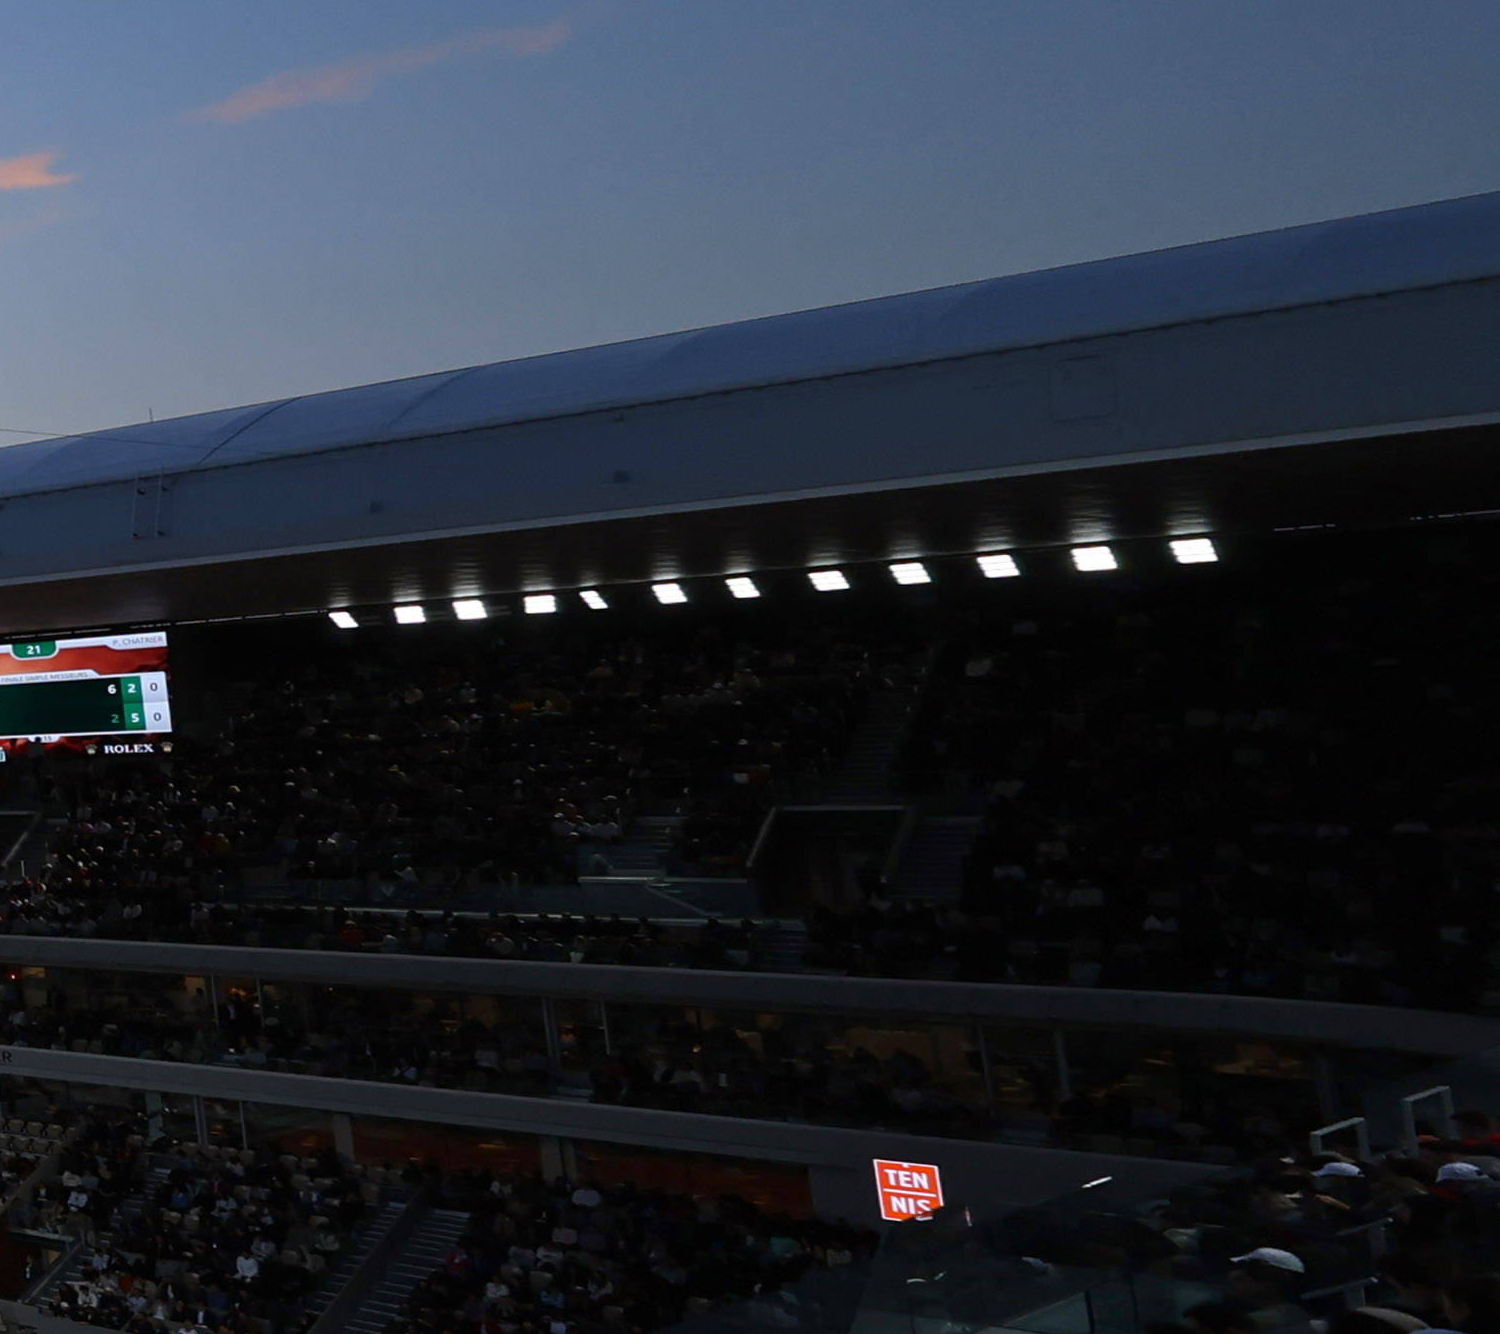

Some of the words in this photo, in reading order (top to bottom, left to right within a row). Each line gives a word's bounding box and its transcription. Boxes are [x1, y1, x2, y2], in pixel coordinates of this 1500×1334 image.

[27, 645, 41, 655] 21
[107, 684, 117, 694] 6
[127, 683, 136, 693] 2
[150, 682, 158, 691] 0
[111, 714, 119, 723] 2
[131, 713, 140, 723] 5
[153, 712, 161, 721] 0
[104, 743, 154, 754] ROLEX
[884, 1168, 930, 1189] TEN
[890, 1195, 932, 1215] NIS
